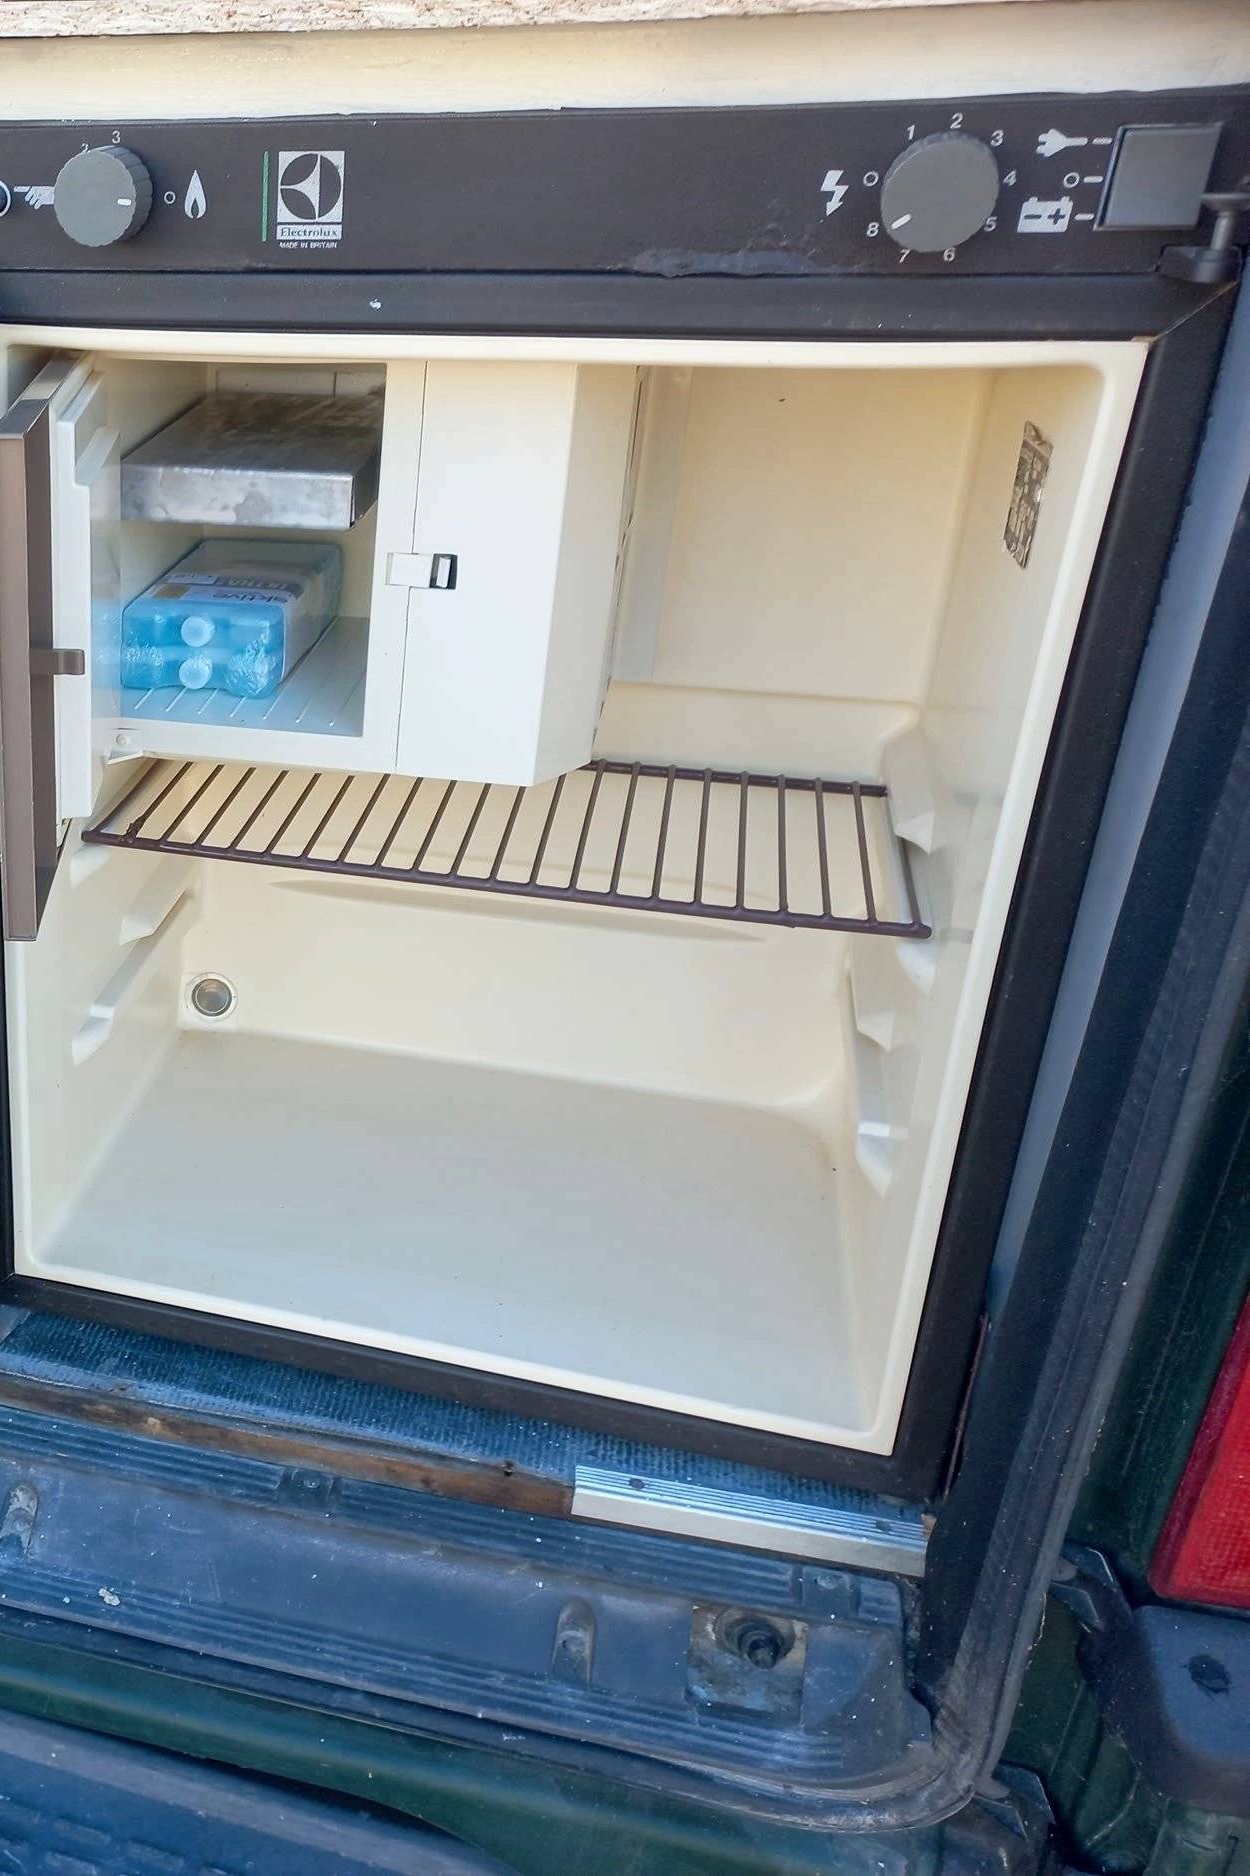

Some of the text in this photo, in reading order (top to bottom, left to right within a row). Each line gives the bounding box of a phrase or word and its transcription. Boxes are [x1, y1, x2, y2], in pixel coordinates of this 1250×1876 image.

[950, 112, 963, 129] 2
[112, 130, 121, 144] 3
[906, 124, 915, 140] 1
[990, 129, 1004, 147] 3
[1003, 170, 1017, 186] 4
[280, 227, 338, 237] Electrolux
[866, 221, 880, 237] 8
[983, 216, 998, 232] 5
[279, 241, 338, 249] MADE IN BRITAIN
[899, 249, 911, 264] 7
[943, 247, 956, 262] 6
